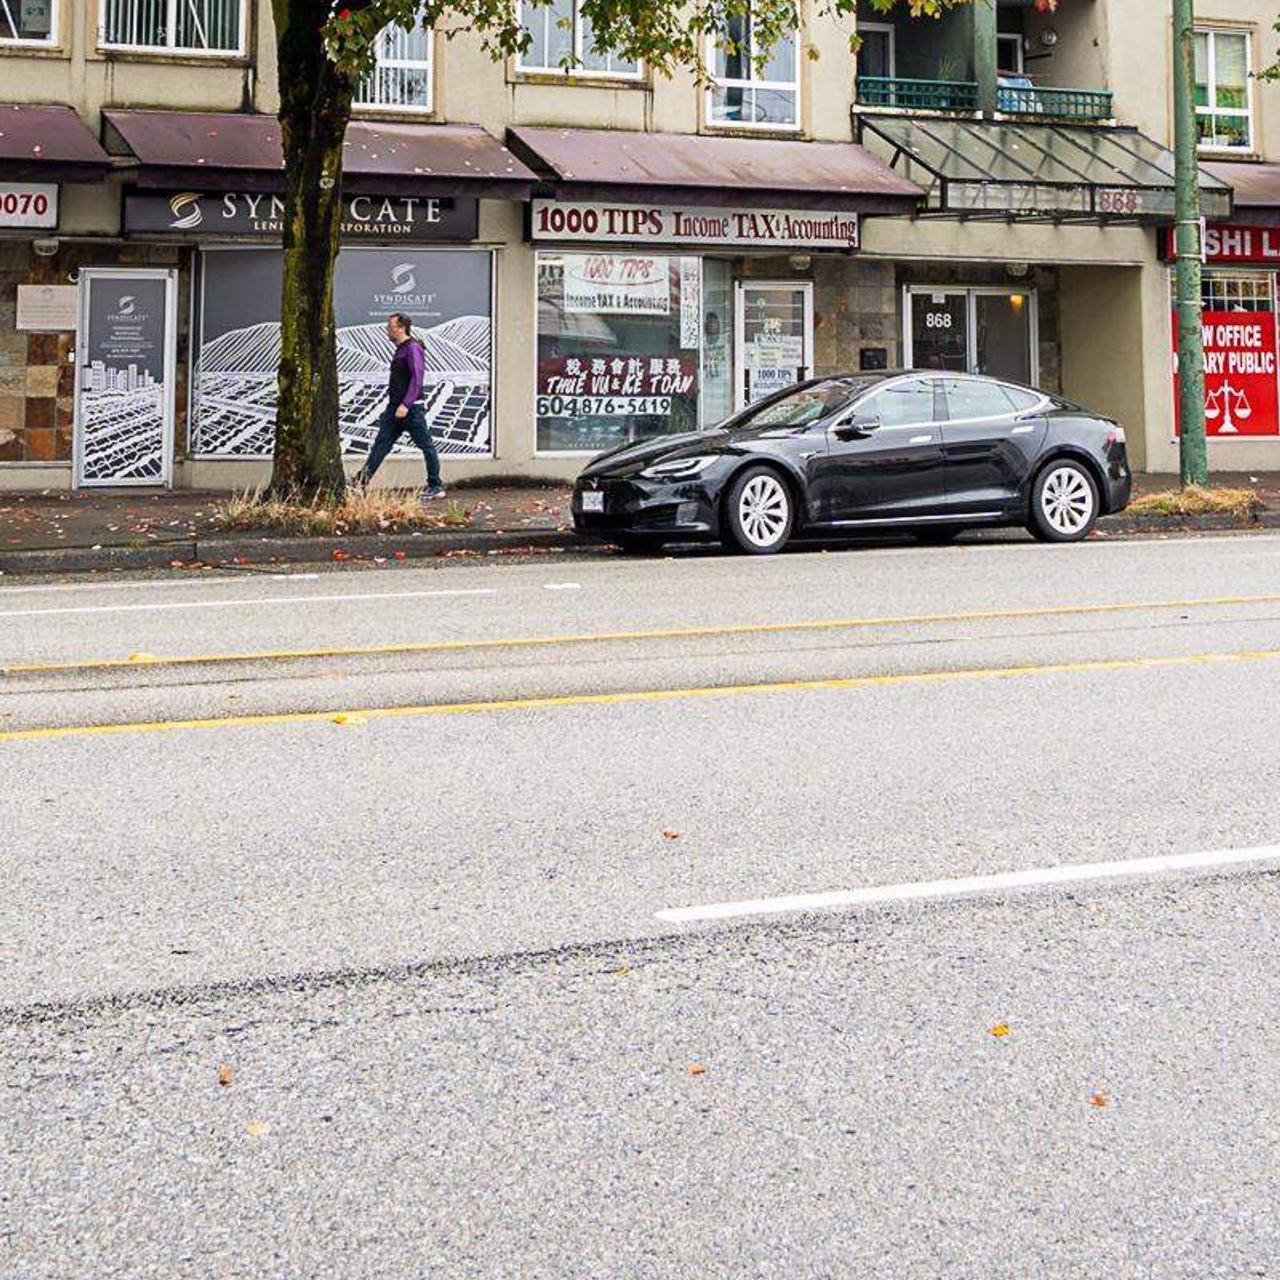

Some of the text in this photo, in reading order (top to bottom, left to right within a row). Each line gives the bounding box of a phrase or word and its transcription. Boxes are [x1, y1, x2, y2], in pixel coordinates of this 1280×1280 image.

[222, 193, 441, 222] SYNCATE
[1100, 192, 1137, 212] 868
[538, 206, 598, 232] 1000
[603, 209, 662, 235] TIPS
[673, 212, 729, 238] Income
[597, 293, 613, 308] TAX
[926, 313, 952, 328] 868
[1216, 325, 1262, 347] OFFICE
[1229, 352, 1275, 374] PUBLIC
[537, 397, 671, 417] 604 876-5419
